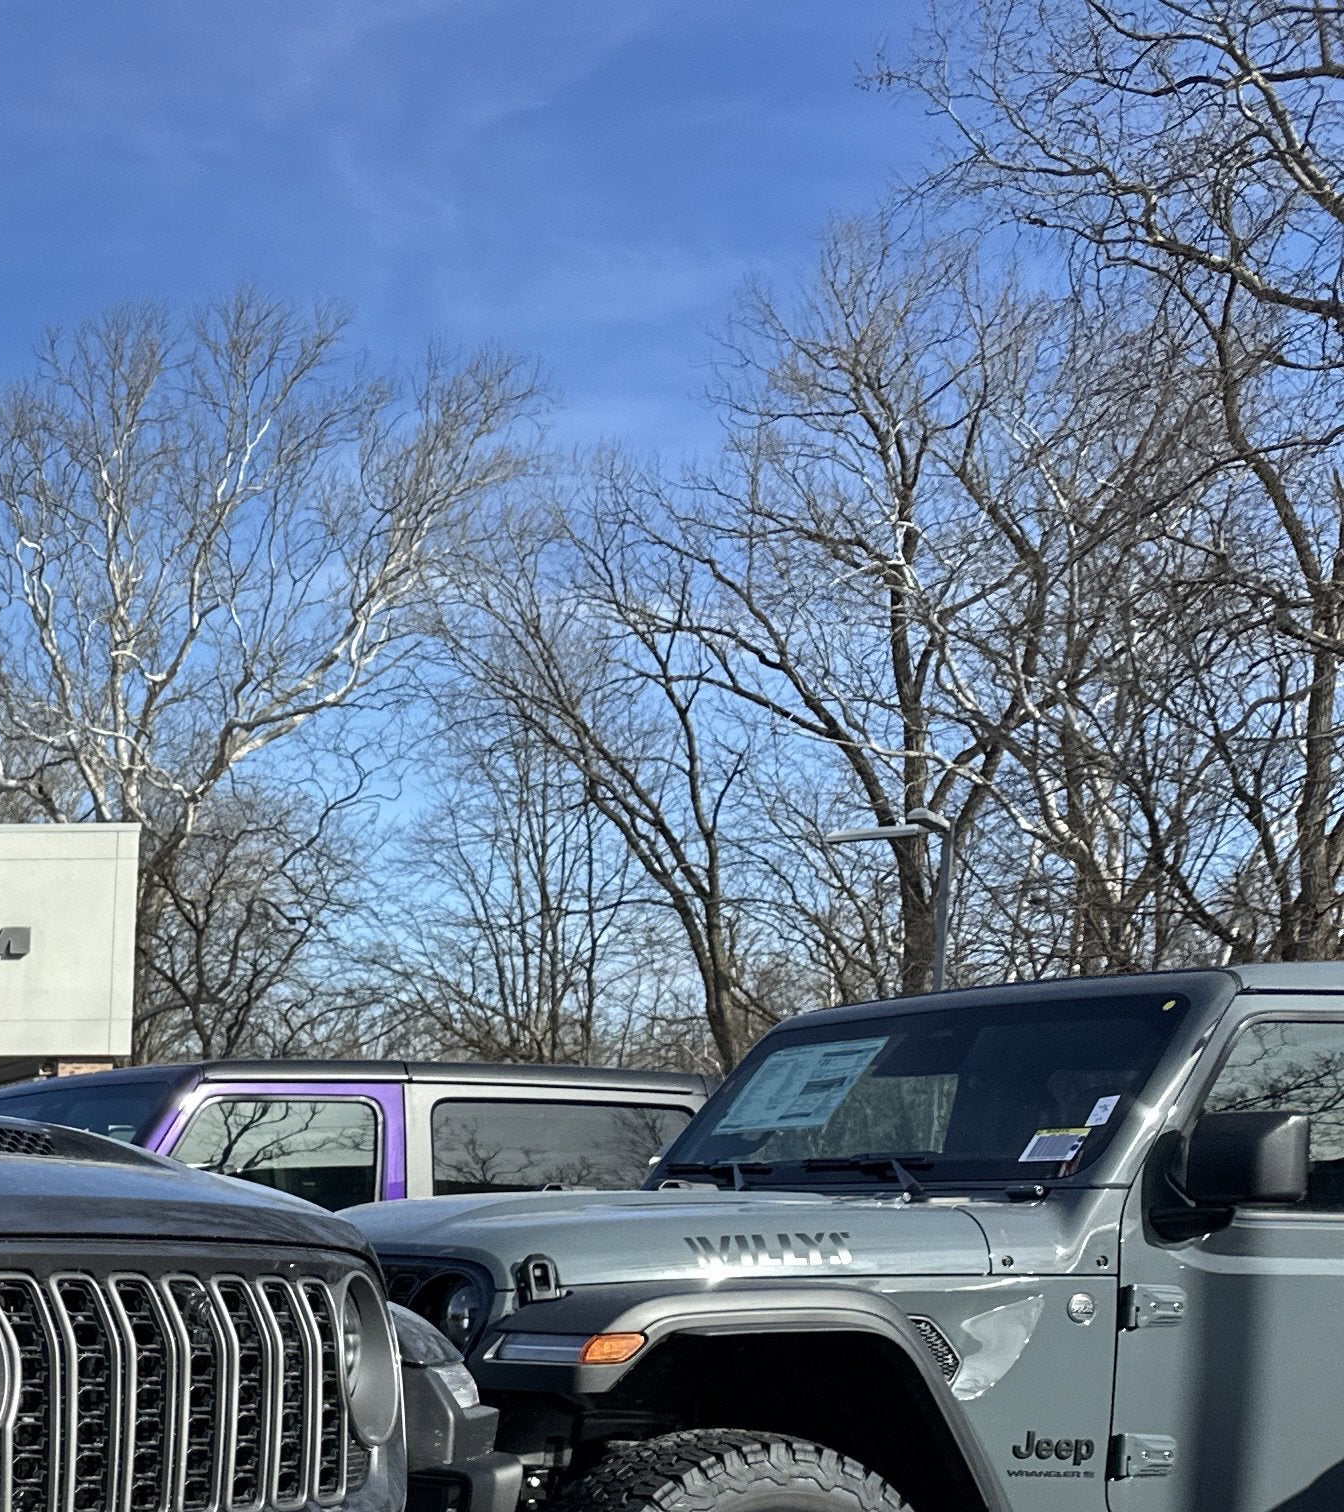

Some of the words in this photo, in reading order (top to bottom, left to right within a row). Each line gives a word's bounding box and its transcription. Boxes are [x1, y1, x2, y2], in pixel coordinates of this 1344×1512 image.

[683, 1231, 853, 1268] WILLYS
[1012, 1430, 1095, 1466] Jeep
[1007, 1469, 1081, 1478] WRANGLER
